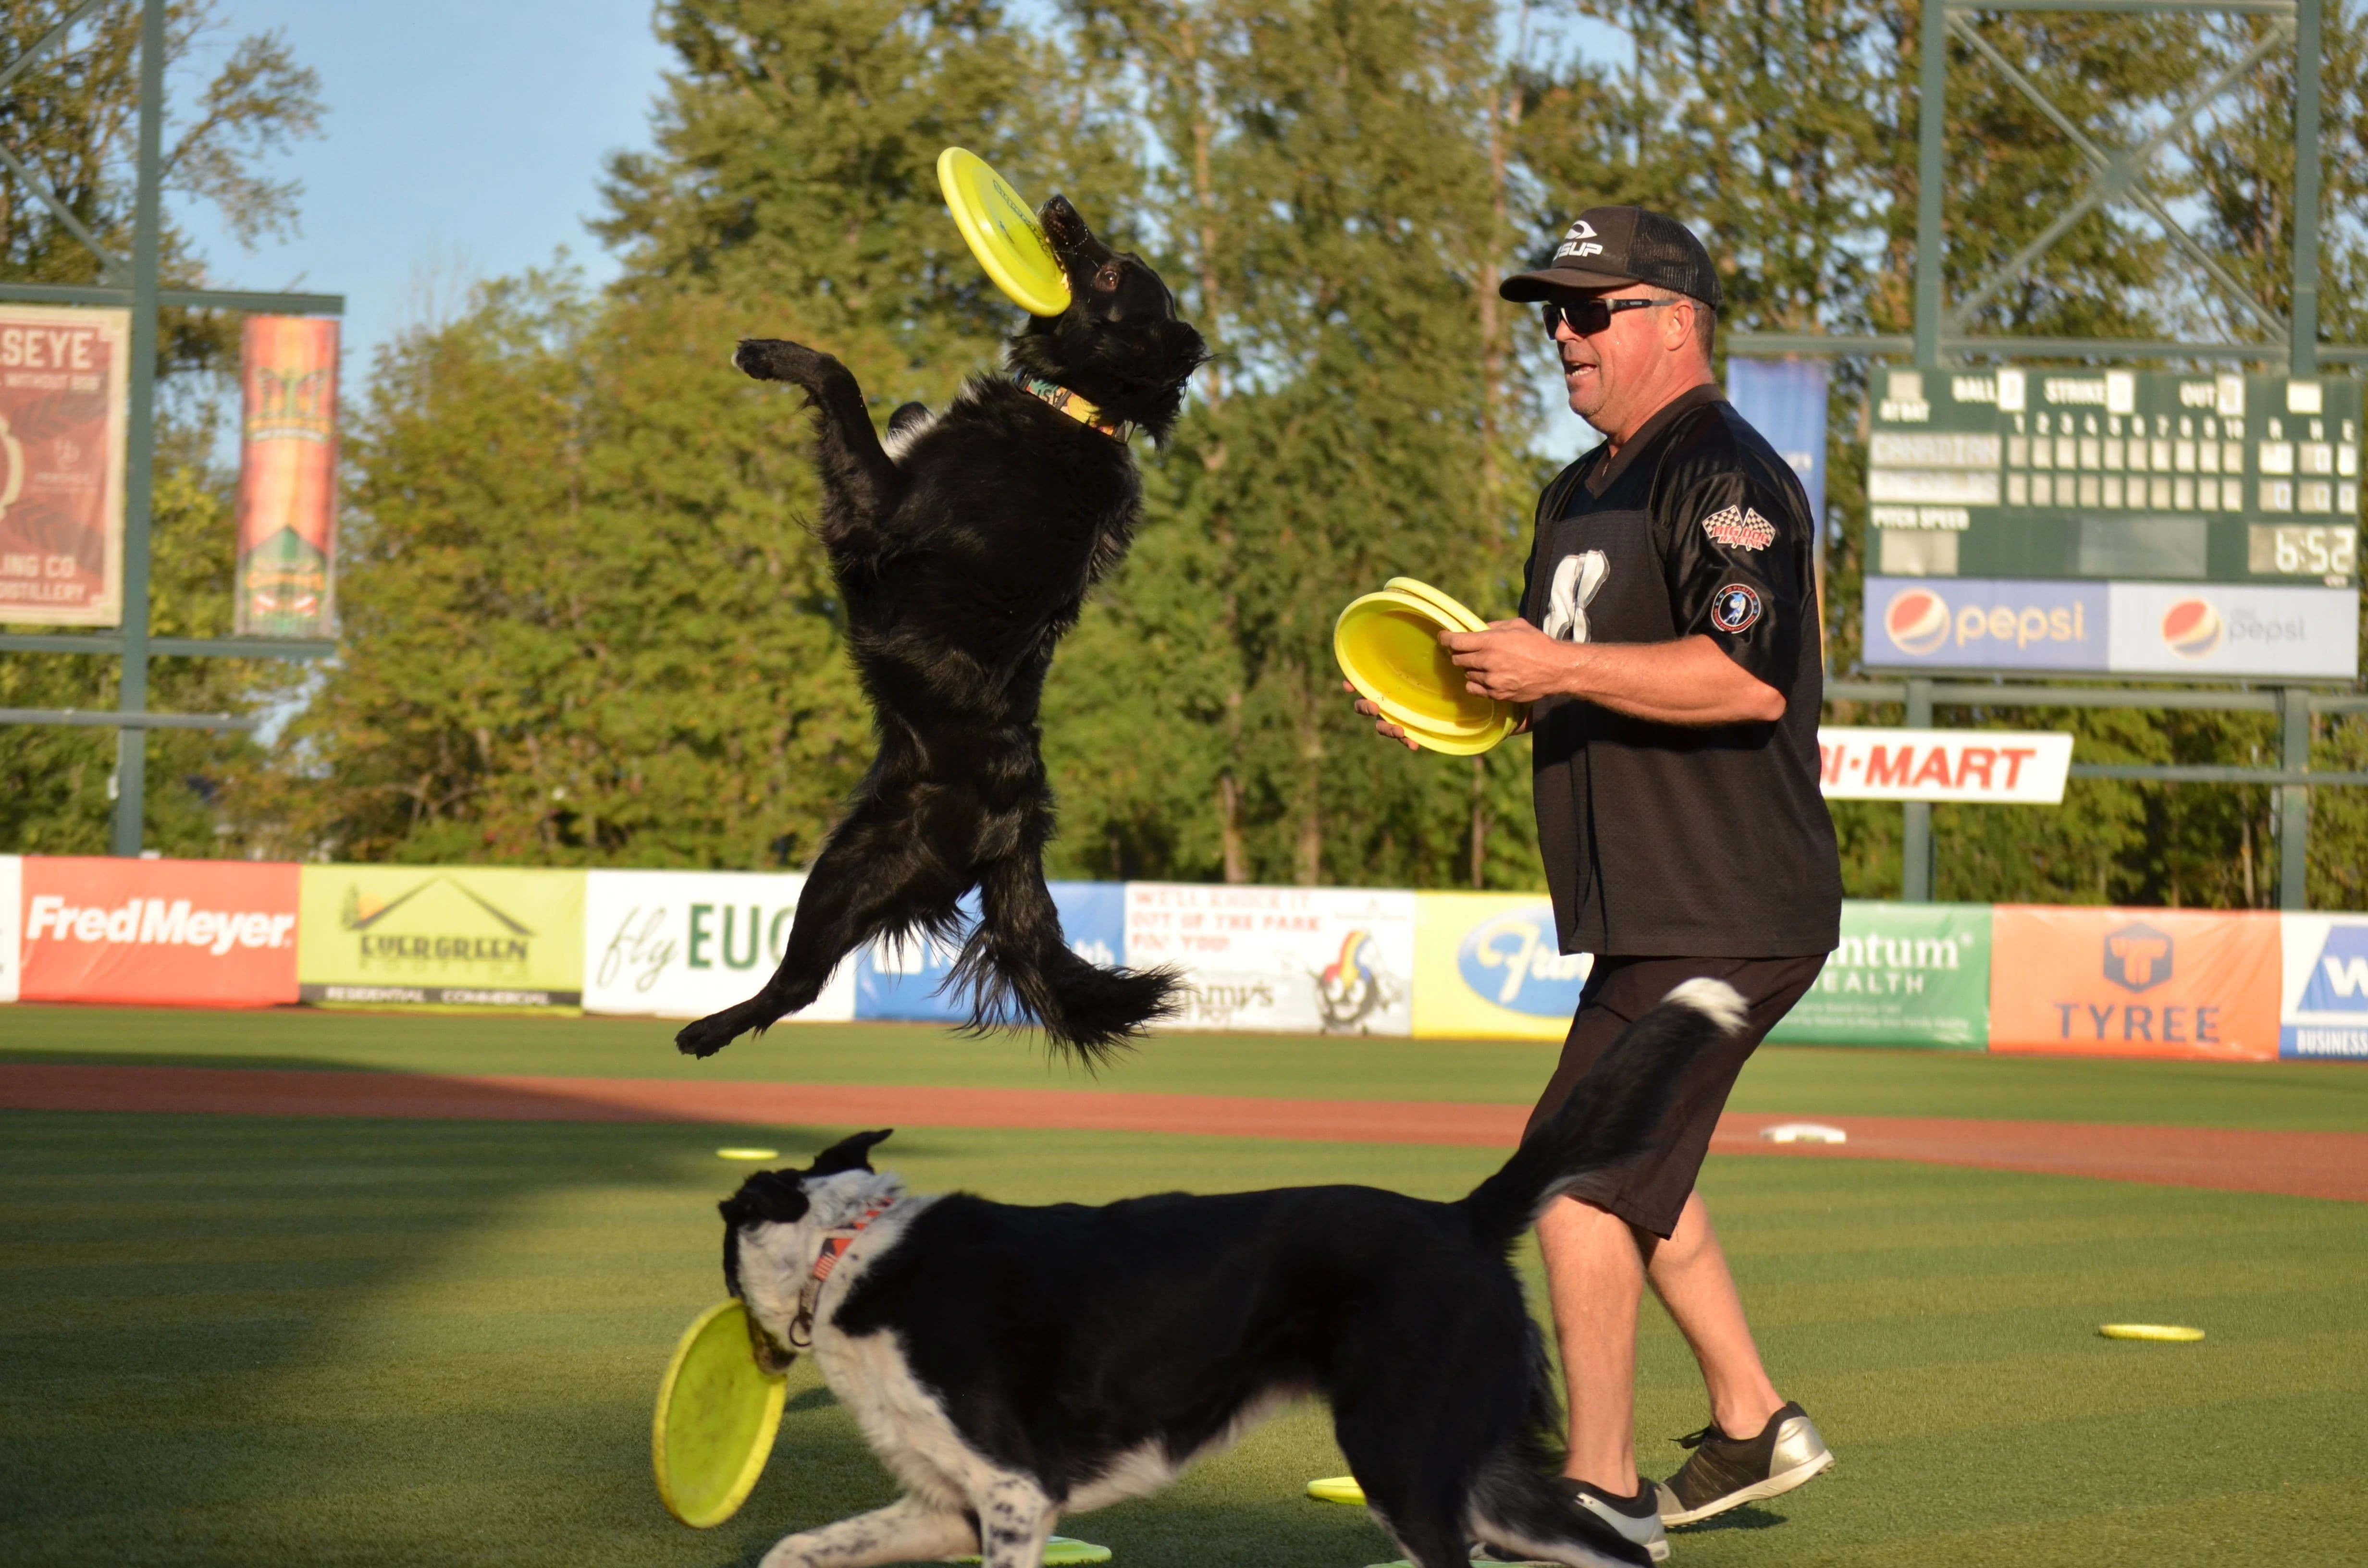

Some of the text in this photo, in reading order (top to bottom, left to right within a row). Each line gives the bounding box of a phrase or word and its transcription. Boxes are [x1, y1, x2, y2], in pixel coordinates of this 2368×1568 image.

[1952, 376, 1997, 403] BALL
[2044, 378, 2107, 404] STRIKE
[2179, 381, 2216, 408] OUT
[1871, 508, 1969, 531] PITCH SPEED
[1713, 526, 1769, 544] BIG DOG
[1719, 535, 1762, 548] RACING
[2275, 527, 2356, 574] 6:52
[1956, 600, 2084, 649] pepsi
[2228, 615, 2306, 647] pepsi
[1216, 914, 1252, 930] THE
[1263, 916, 1320, 931] PARK
[595, 905, 679, 993] fly
[1826, 932, 1959, 969] ntum
[1811, 972, 1924, 994] EALTH
[2055, 1003, 2220, 1043] TYREE
[2296, 1028, 2368, 1055] BUSINESS
